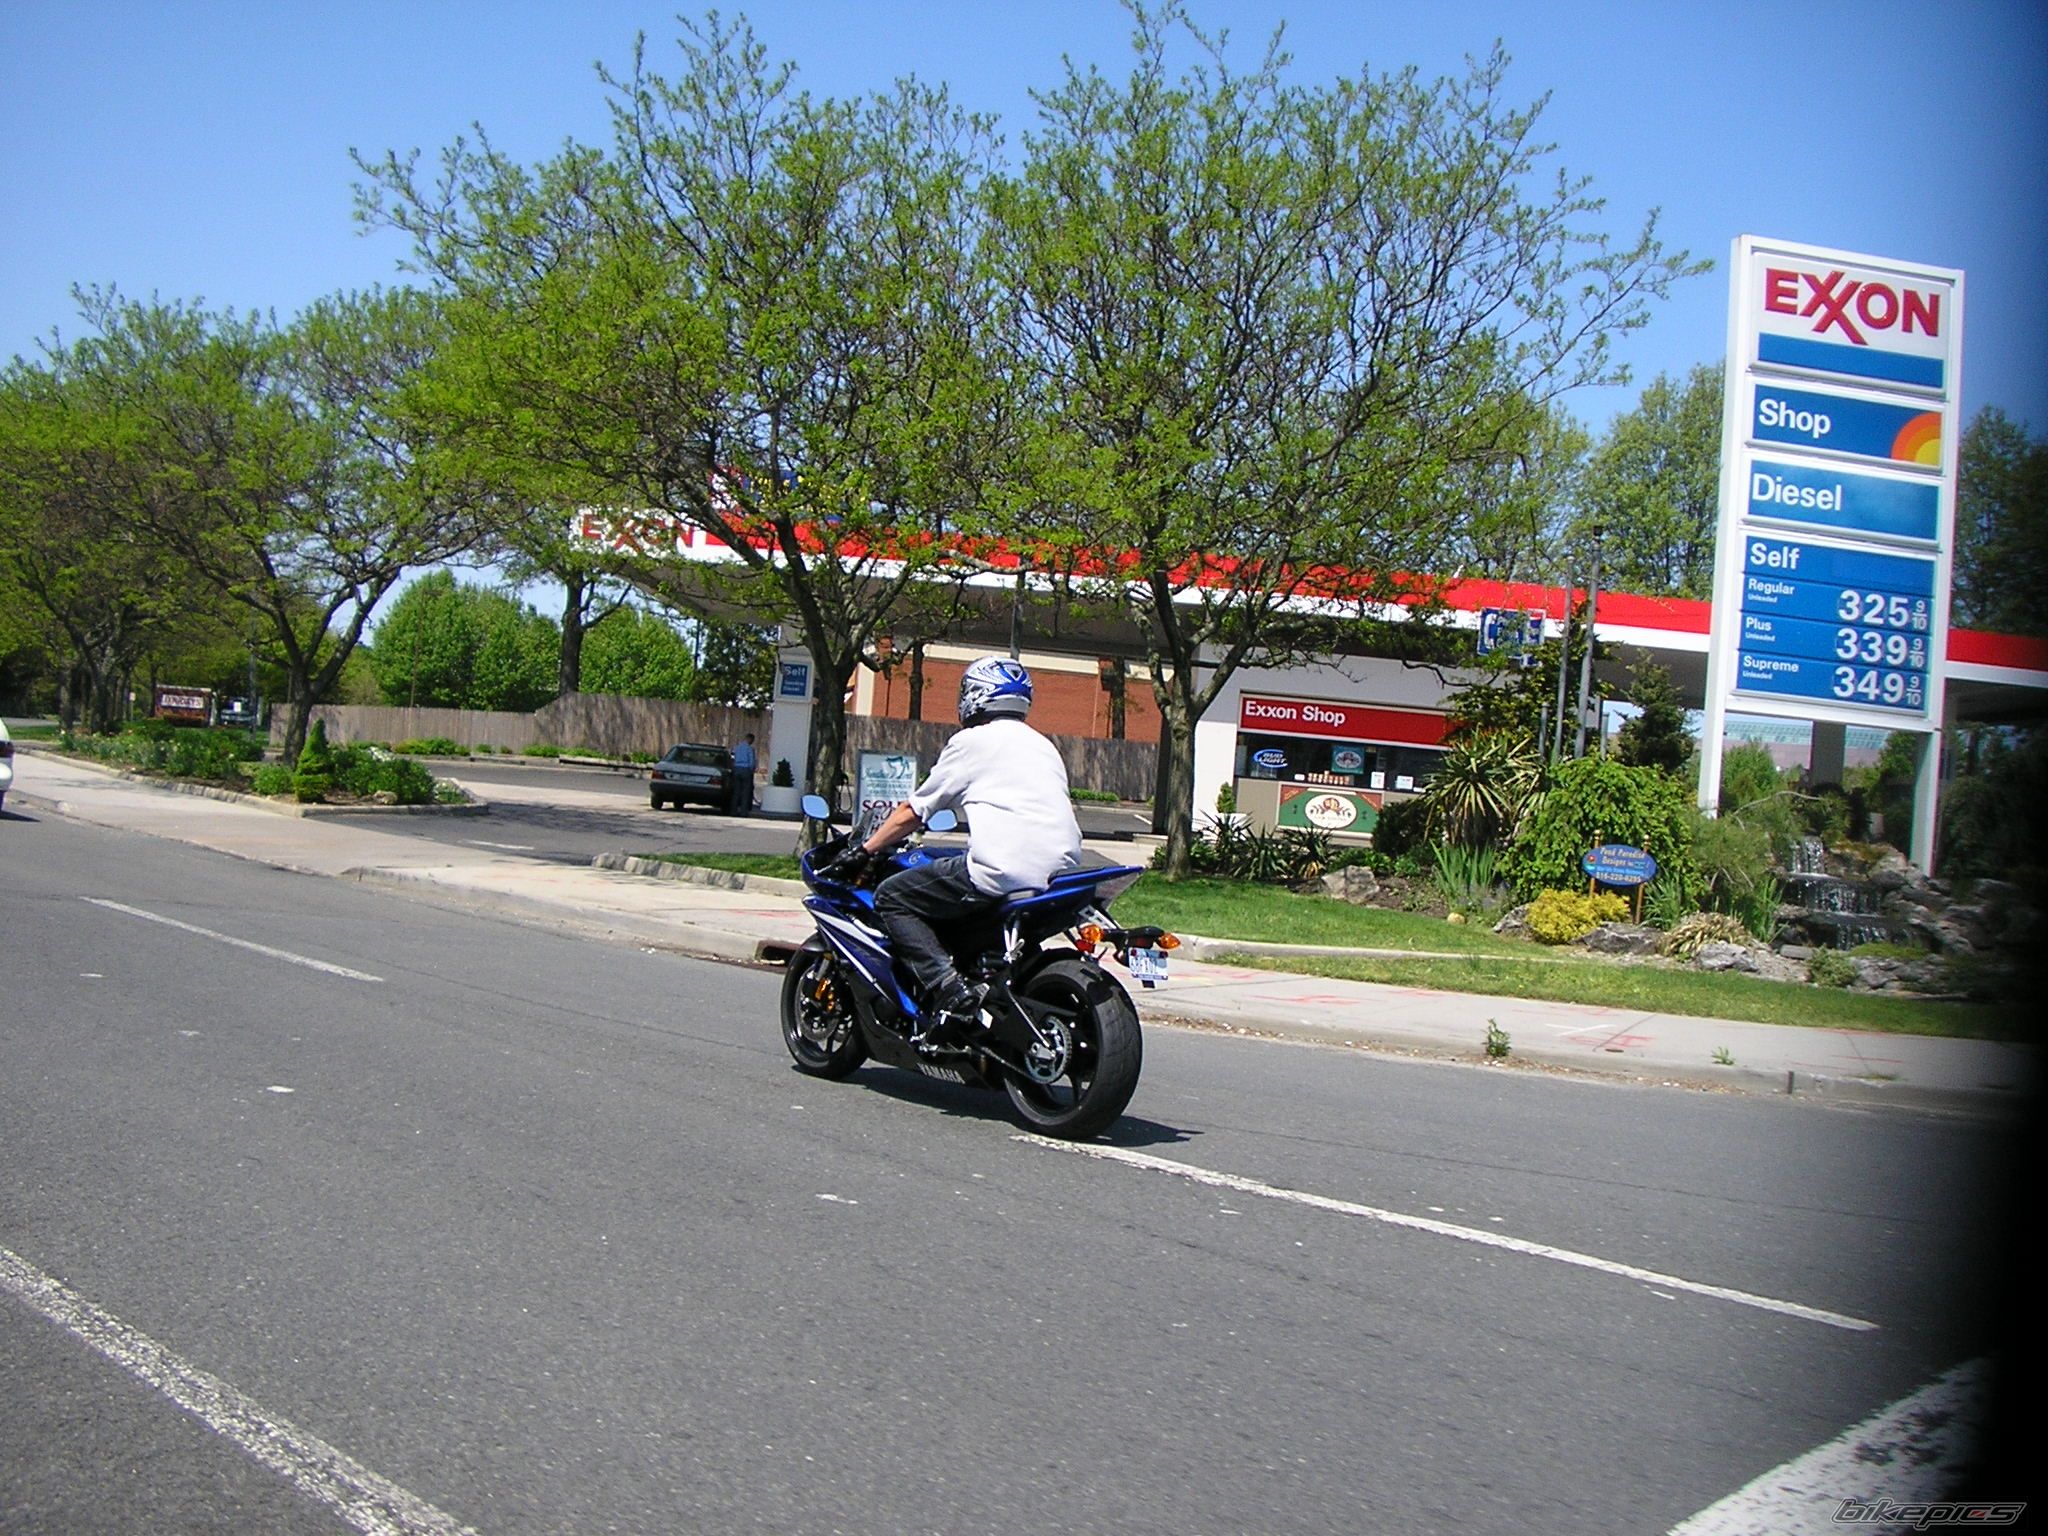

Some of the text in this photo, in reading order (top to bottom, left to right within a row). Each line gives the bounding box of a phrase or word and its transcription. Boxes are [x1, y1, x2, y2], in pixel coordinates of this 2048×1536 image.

[1765, 268, 1940, 345] EXXON
[1759, 399, 1831, 438] Shop
[1752, 473, 1841, 511] Diesel
[1750, 543, 1800, 569] Self
[1748, 578, 1795, 595] Regular
[1838, 589, 1909, 627] 325
[1745, 617, 1772, 631] Plus
[1836, 627, 1907, 665] 339
[784, 665, 806, 676] Self
[1743, 656, 1799, 673] Supreme
[1833, 665, 1904, 703] 349
[1245, 701, 1346, 727] Exxon Shop
[916, 1062, 966, 1085] YAMAHA
